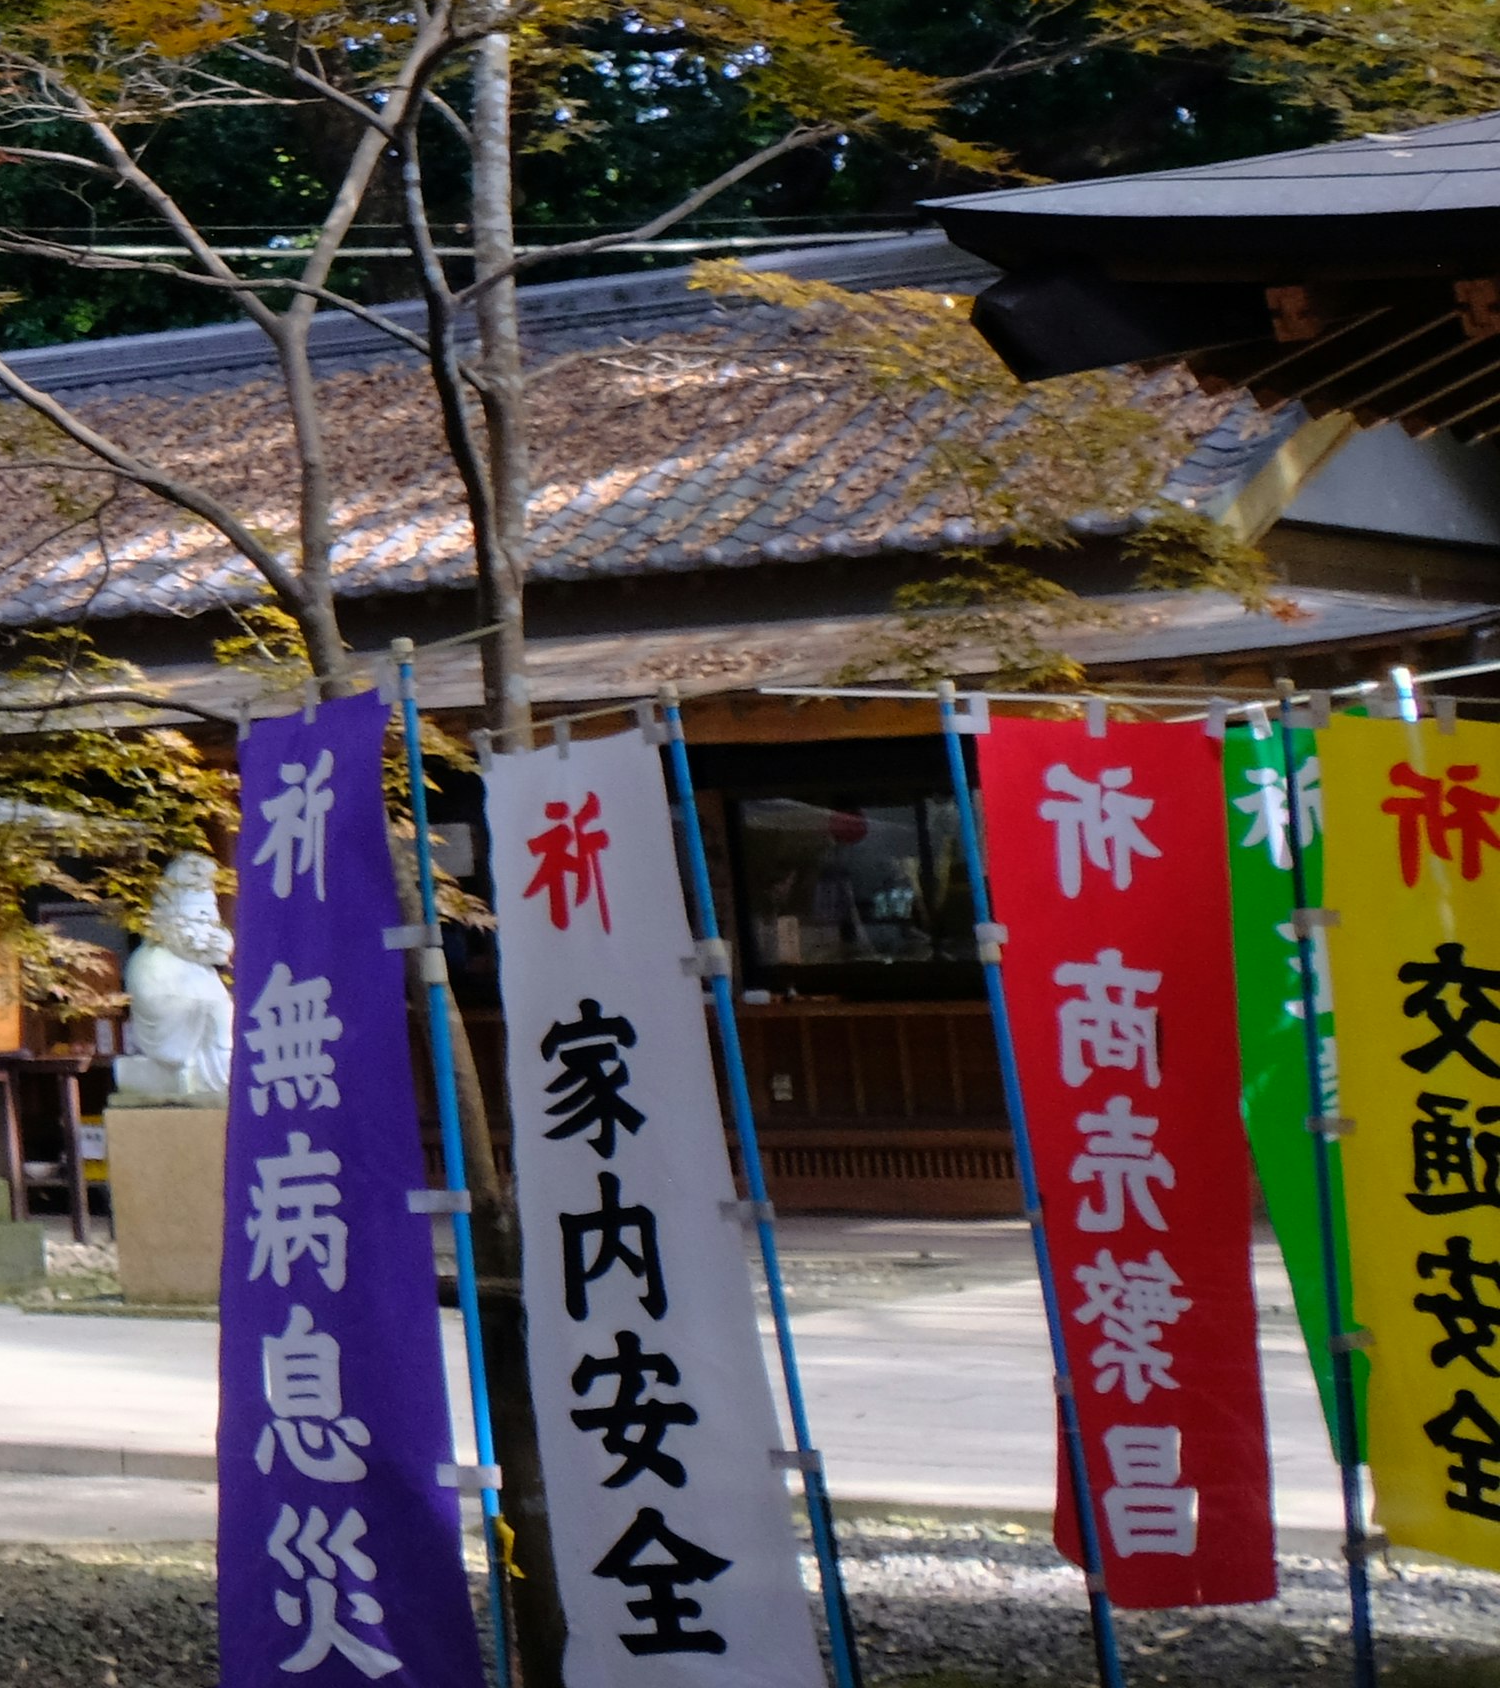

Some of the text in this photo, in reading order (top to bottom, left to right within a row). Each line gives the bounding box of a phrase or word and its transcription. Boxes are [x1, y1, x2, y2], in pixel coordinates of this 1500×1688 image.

[244, 748, 403, 1679] 祈 無病息災
[523, 791, 734, 1657] 祈 家内安全
